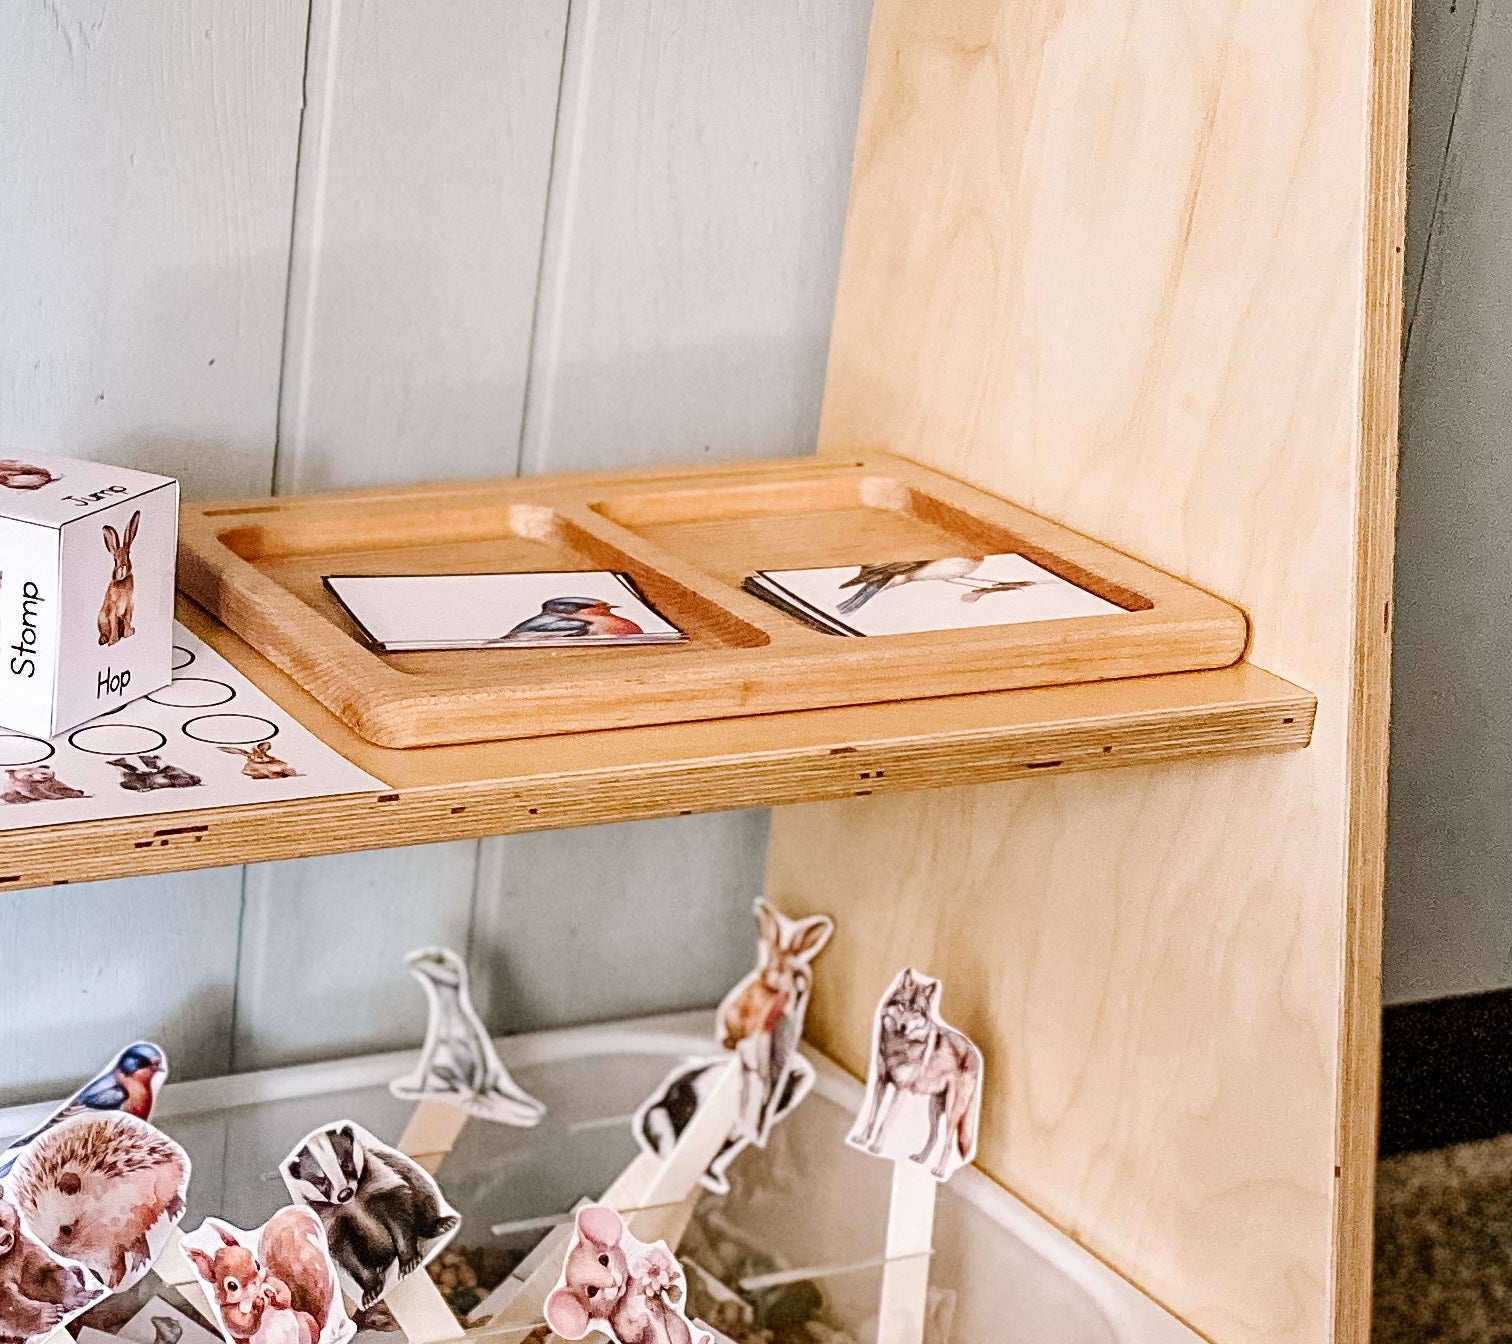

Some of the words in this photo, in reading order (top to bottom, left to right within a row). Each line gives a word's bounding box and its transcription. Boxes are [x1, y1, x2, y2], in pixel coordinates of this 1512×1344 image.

[61, 485, 129, 506] Jump
[10, 581, 45, 678] Stomp
[97, 666, 131, 699] Hop
